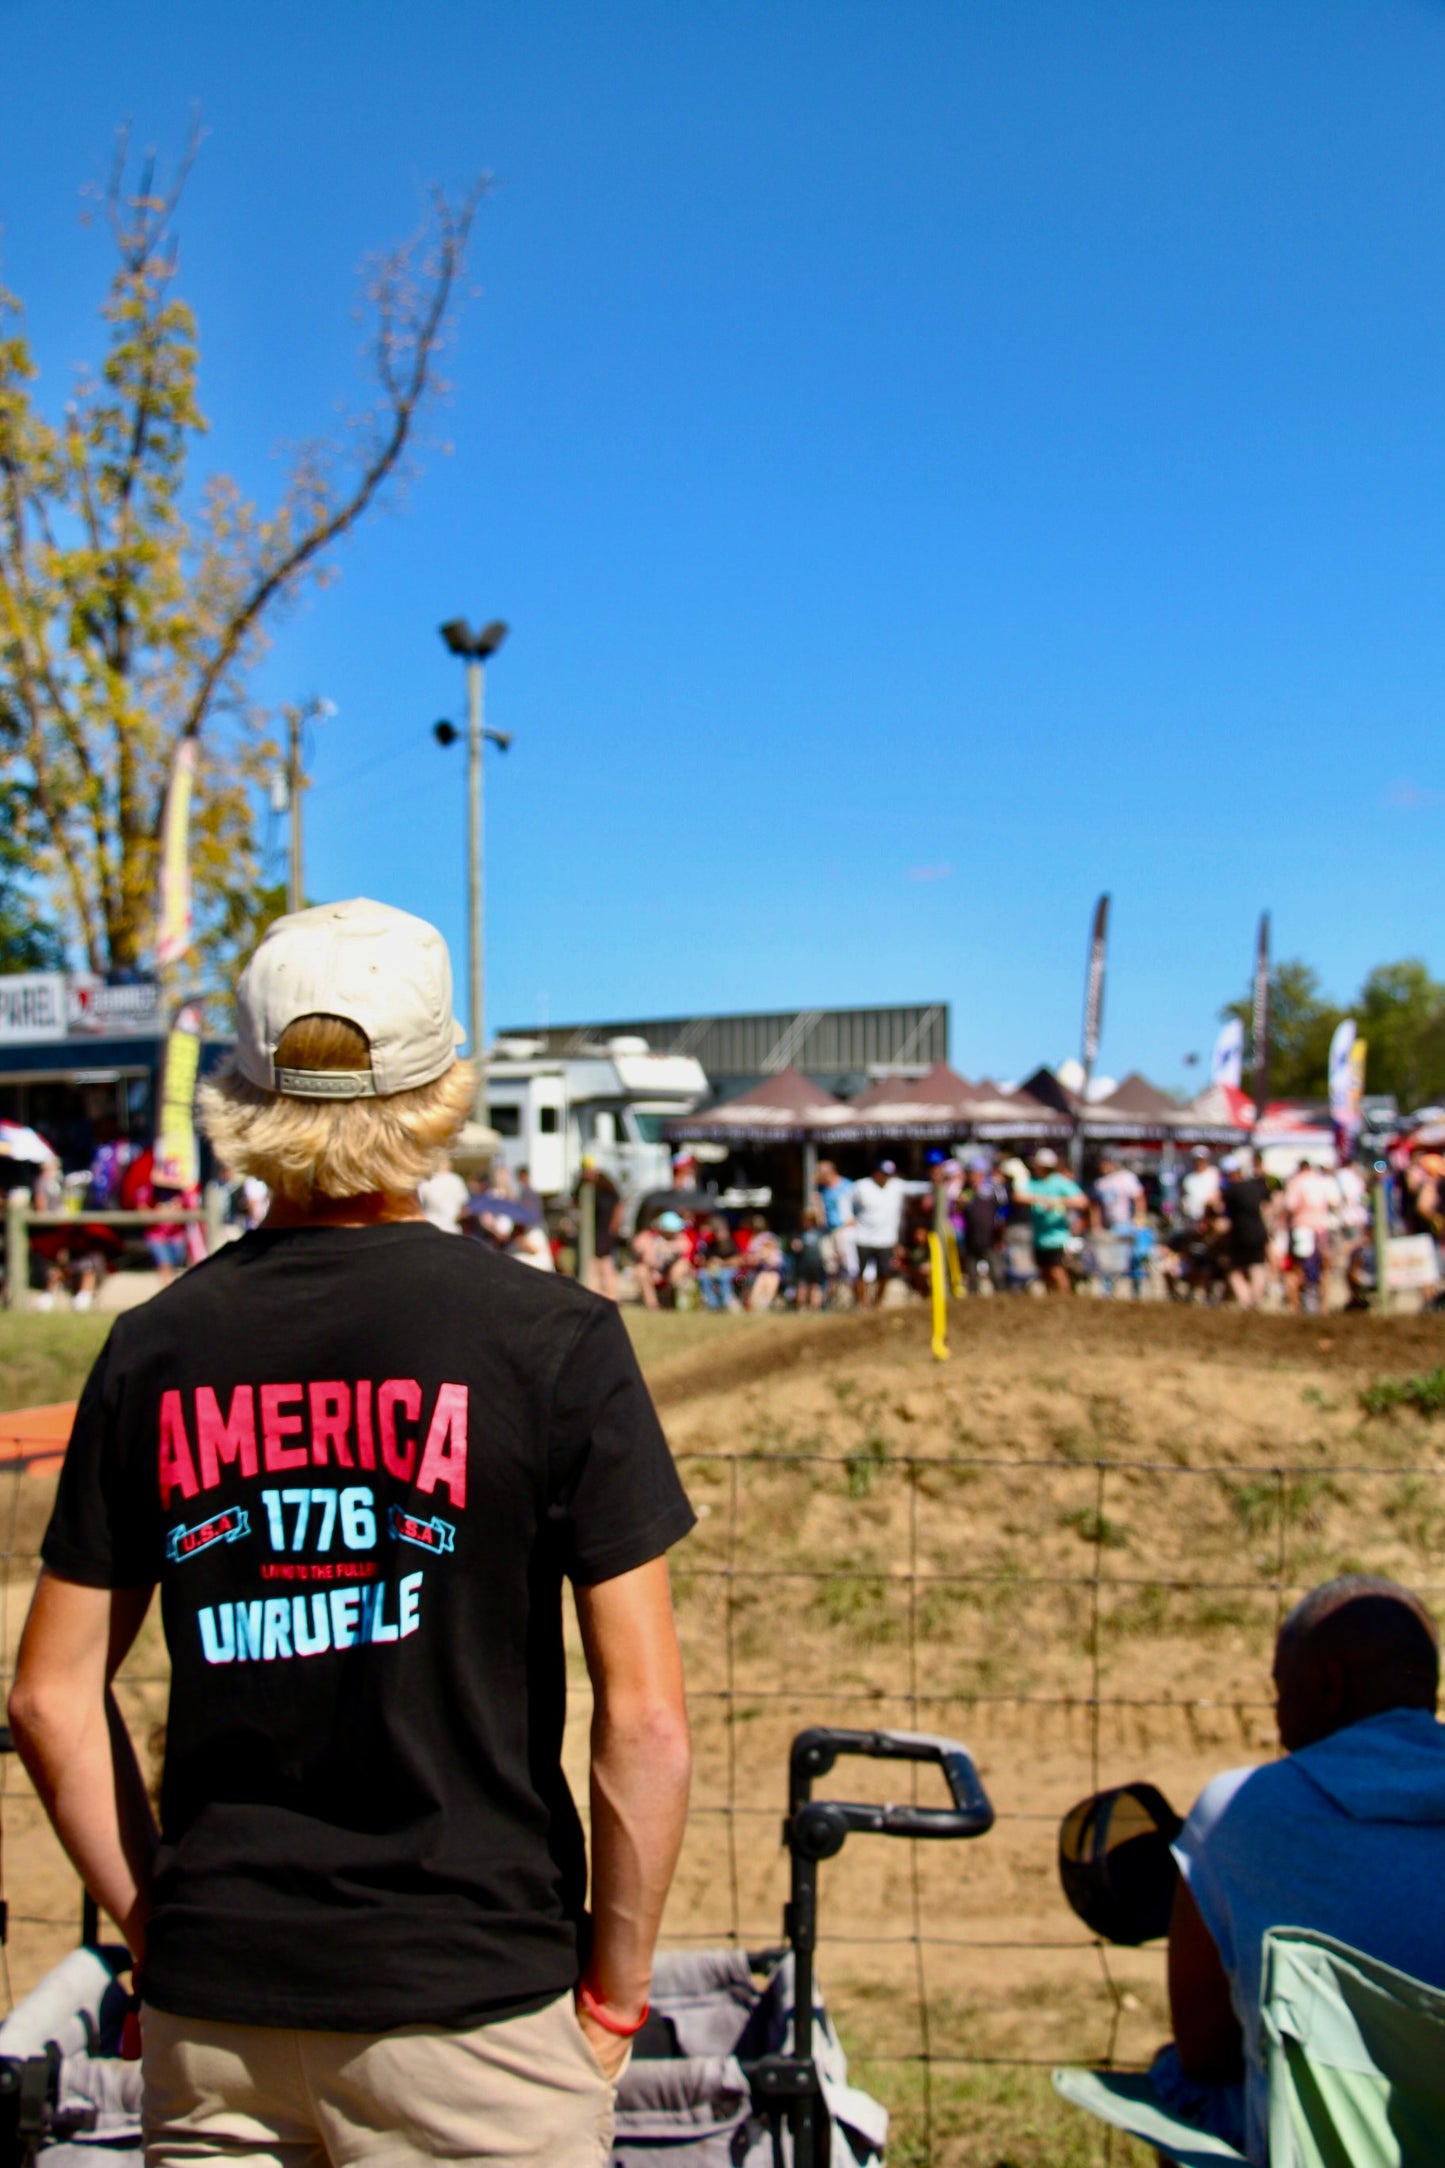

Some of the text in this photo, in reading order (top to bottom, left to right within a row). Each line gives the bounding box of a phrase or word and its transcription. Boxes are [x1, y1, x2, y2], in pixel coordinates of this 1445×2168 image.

[158, 1379, 469, 1512] AMERICA
[261, 1486, 377, 1551] 1776
[310, 1564, 334, 1580] THE
